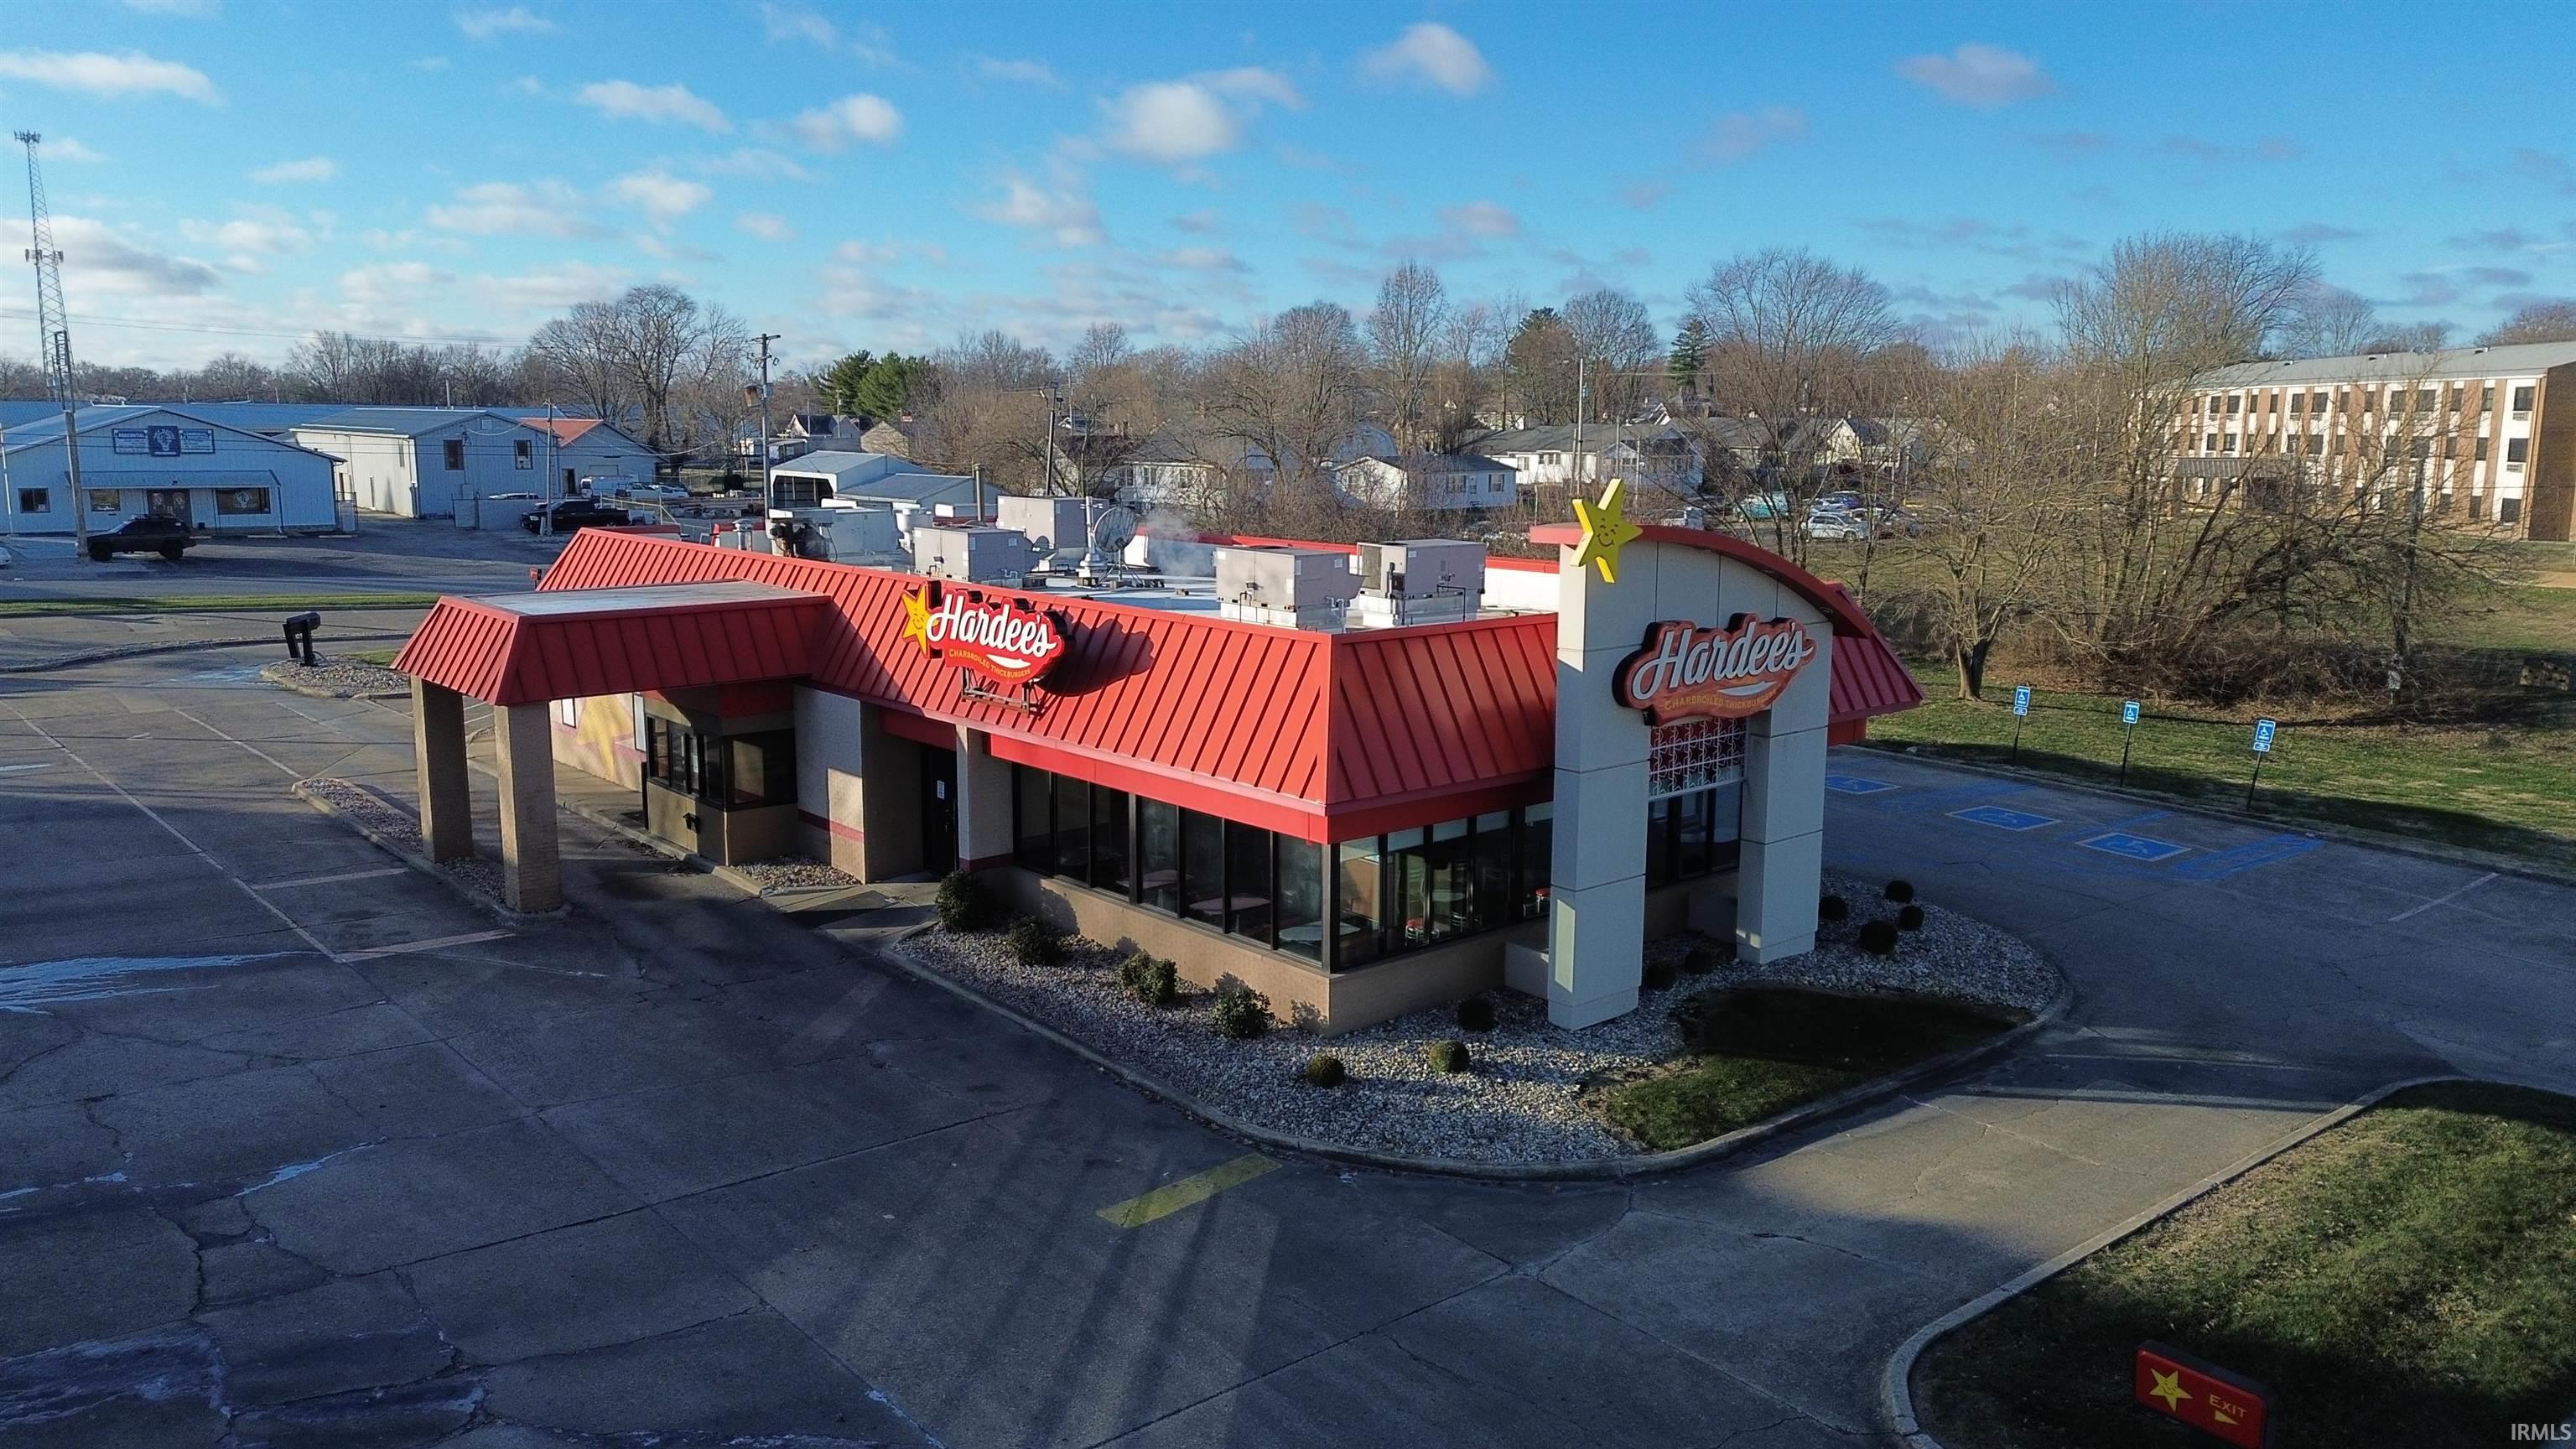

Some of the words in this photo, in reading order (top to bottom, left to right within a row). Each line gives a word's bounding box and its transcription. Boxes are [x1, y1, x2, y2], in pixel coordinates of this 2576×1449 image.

[926, 594, 1057, 657] Hardee's
[948, 648, 990, 668] CHARBROILED
[1632, 621, 1813, 700] Hardee's
[2209, 1394, 2247, 1418] EXIT
